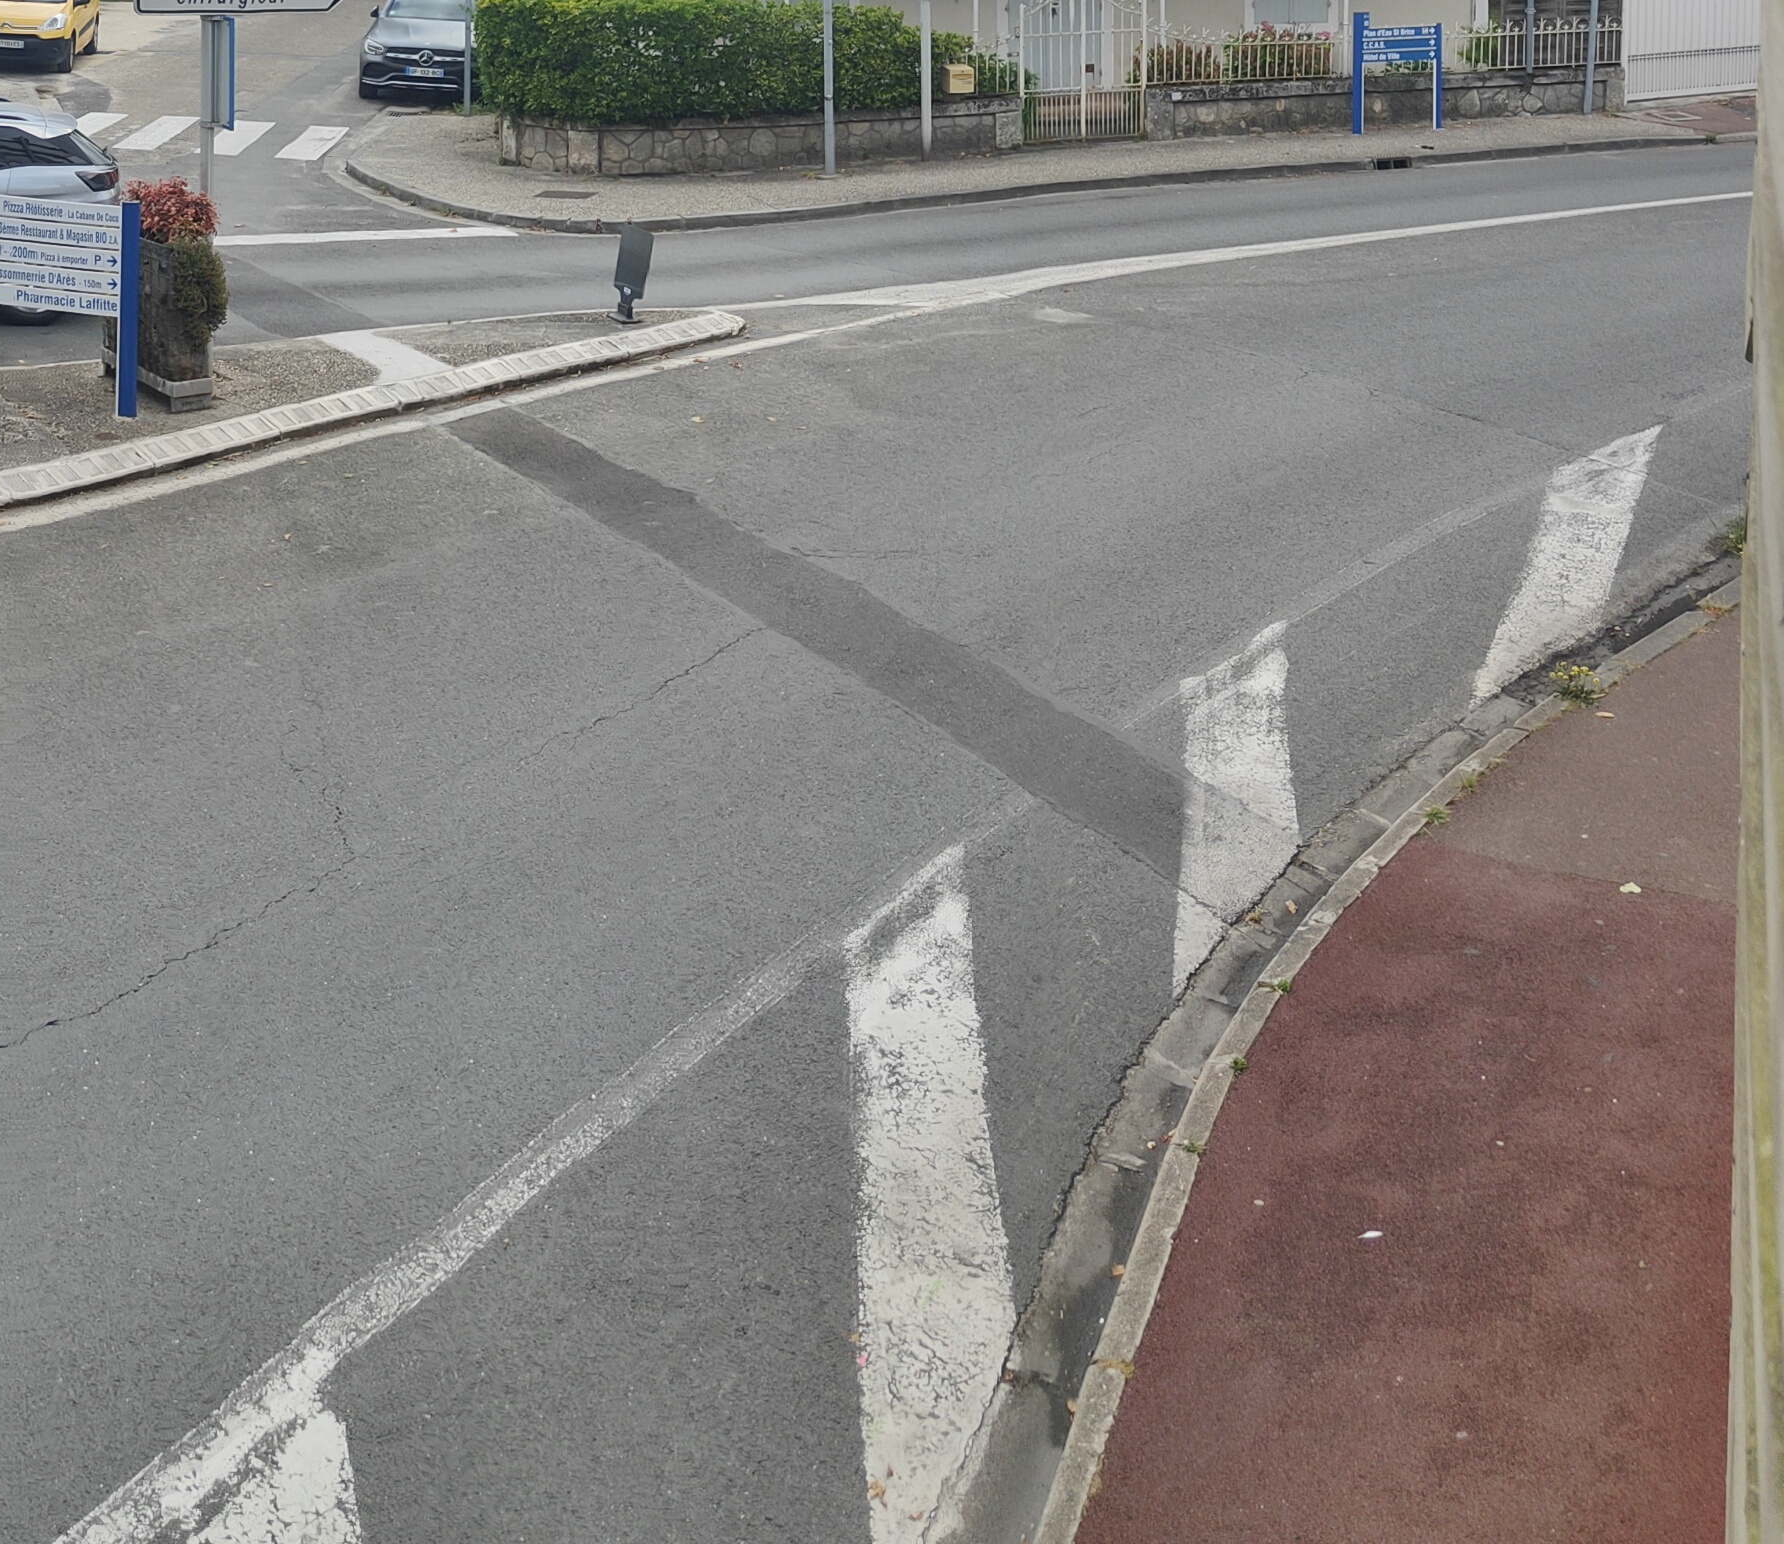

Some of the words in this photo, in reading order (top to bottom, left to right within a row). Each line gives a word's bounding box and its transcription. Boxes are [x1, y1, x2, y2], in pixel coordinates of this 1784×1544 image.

[1363, 29, 1376, 37] Plan
[1377, 29, 1392, 37] d'Eau
[1400, 28, 1415, 36] Brice
[1363, 41, 1386, 49] C.C.A.S.
[1363, 53, 1378, 61] Hôtel
[1387, 52, 1400, 60] Ville
[59, 228, 64, 240] &
[66, 229, 94, 244] Magasin
[95, 231, 107, 244] BIO
[61, 256, 88, 265] emporter
[48, 272, 76, 287] D'Arès
[83, 279, 102, 289] 150m
[79, 297, 118, 312] Laffitte
